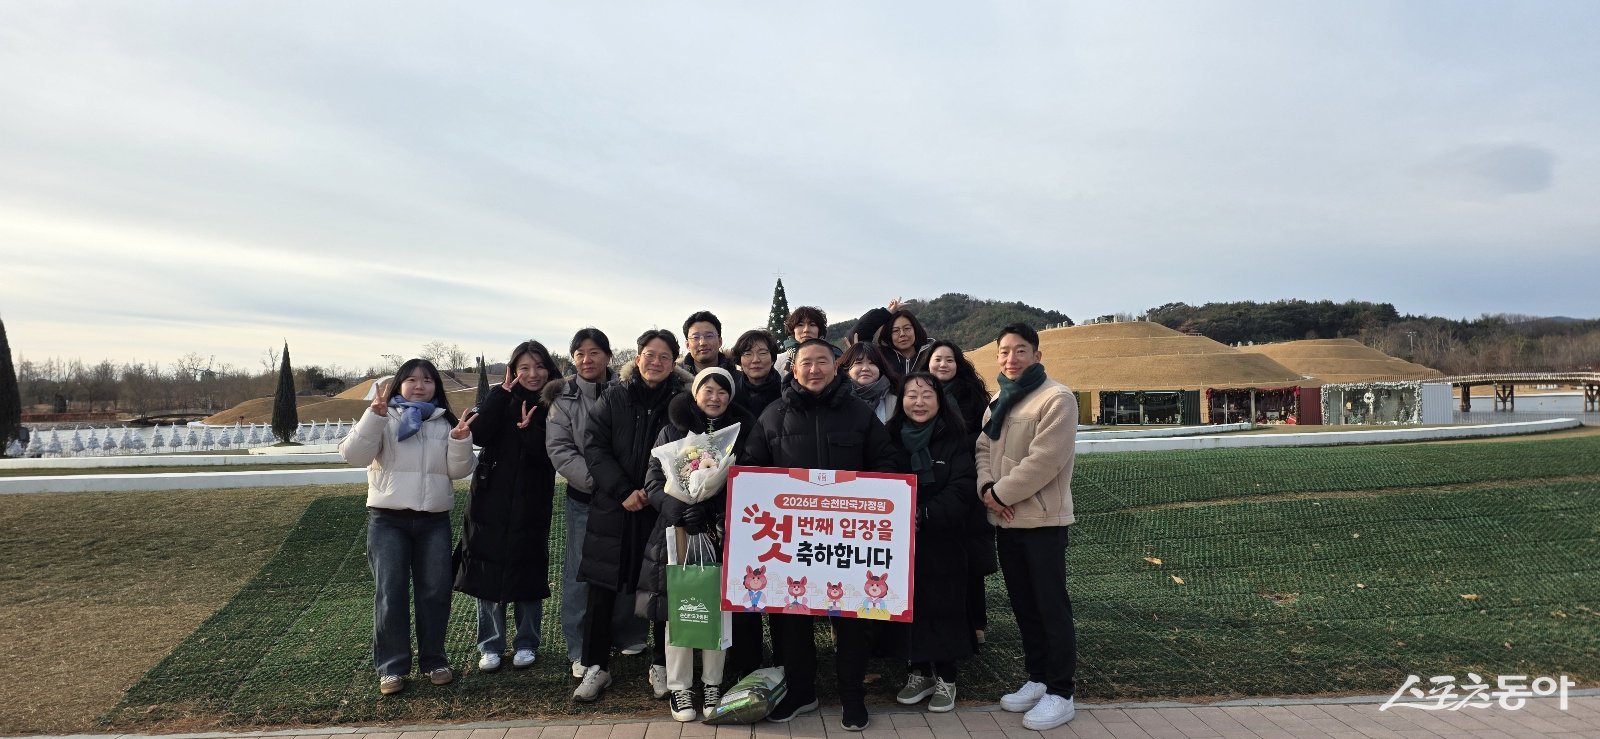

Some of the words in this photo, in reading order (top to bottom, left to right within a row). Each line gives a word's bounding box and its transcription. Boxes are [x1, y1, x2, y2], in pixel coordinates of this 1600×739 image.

[782, 496, 818, 508] 2026년
[820, 498, 886, 512] 순천만국가정원
[751, 510, 793, 564] 첫
[797, 516, 834, 536] 번째
[839, 517, 894, 542] 입장을
[796, 541, 893, 569] 축하합니다
